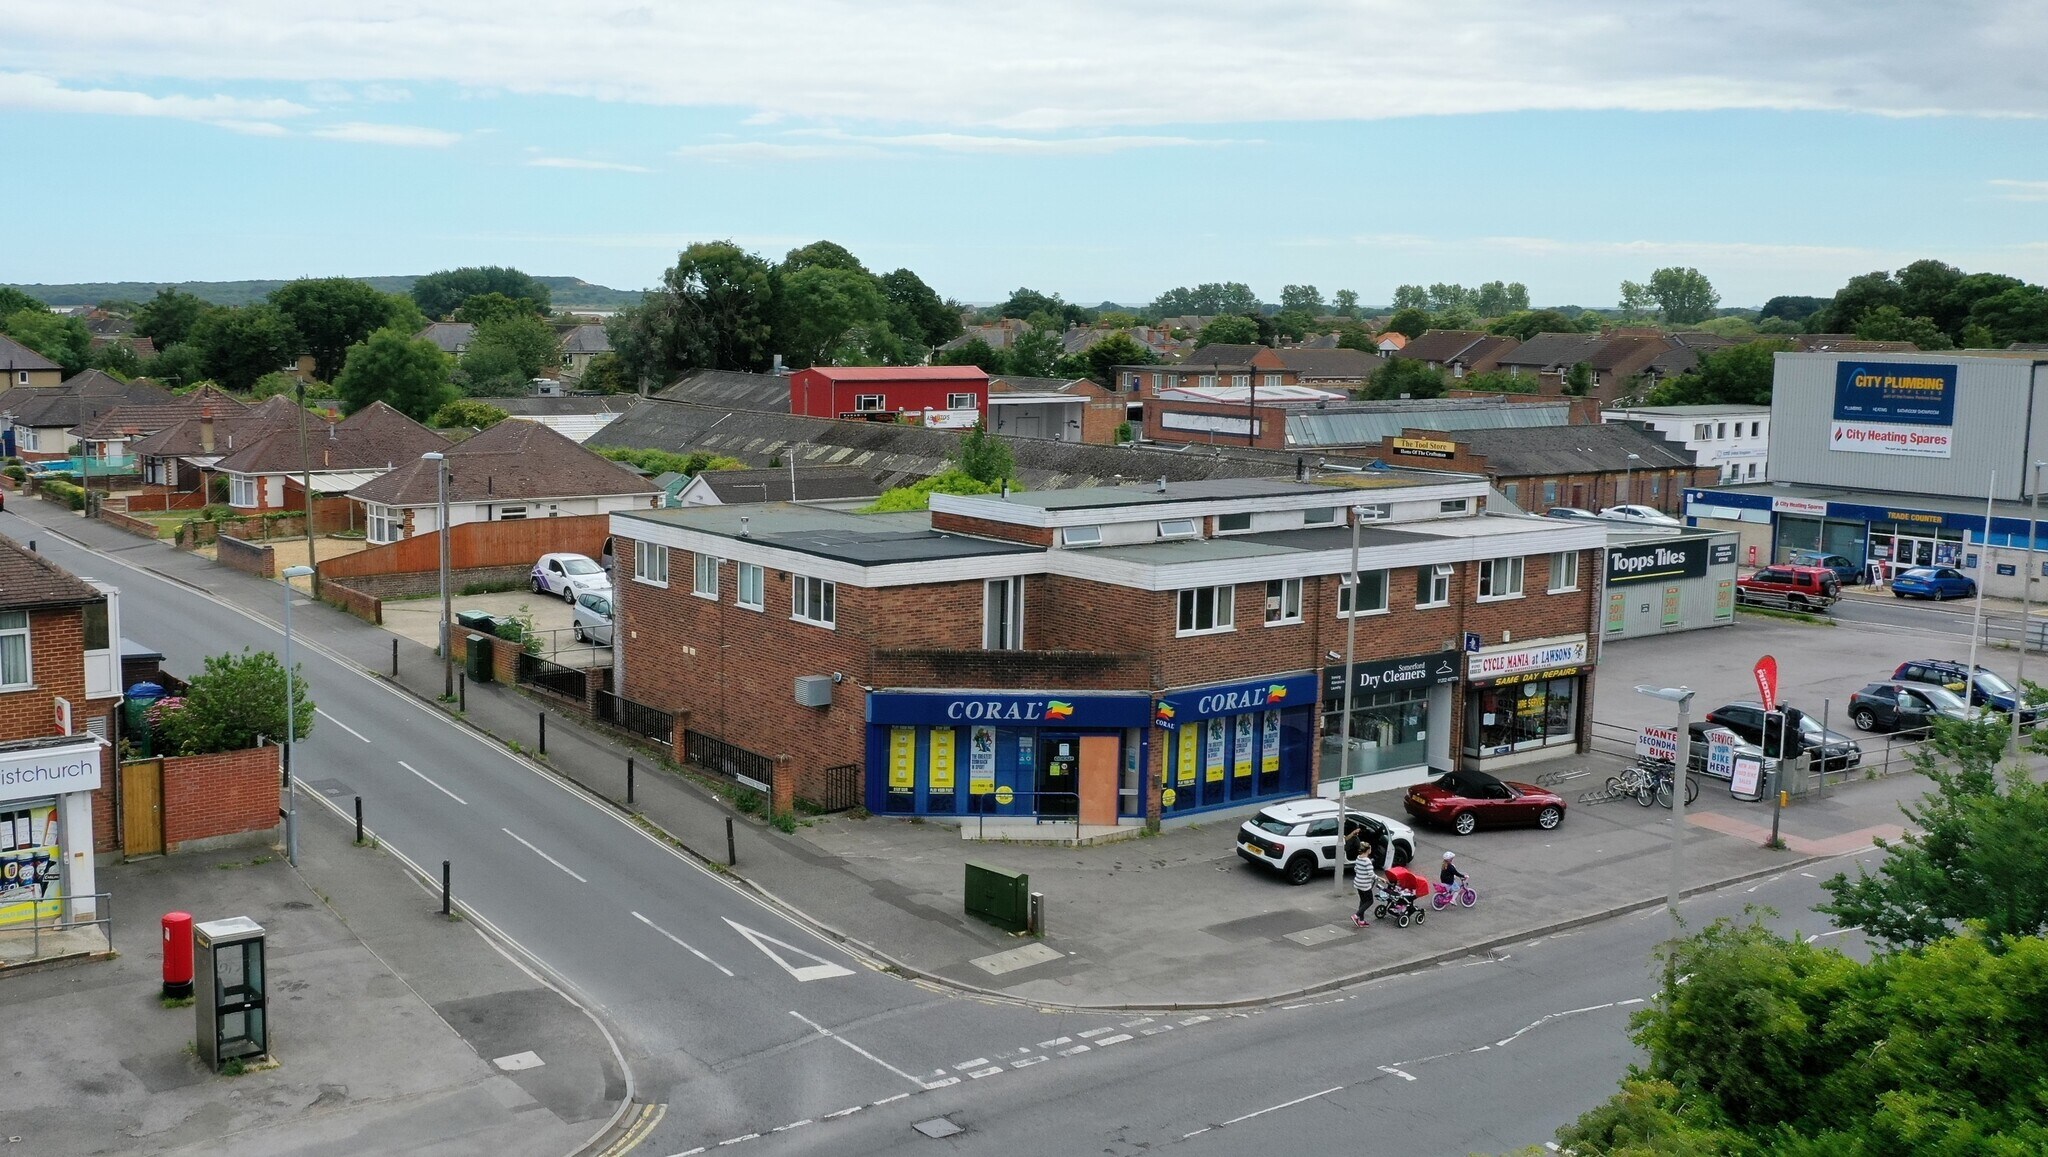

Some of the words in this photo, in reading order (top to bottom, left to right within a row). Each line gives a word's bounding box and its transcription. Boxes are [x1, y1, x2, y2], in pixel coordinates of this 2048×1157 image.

[1855, 375, 1882, 388] CITY
[1884, 376, 1944, 390] PLUMBING
[1846, 428, 1866, 440] City
[1868, 430, 1907, 444] Heating
[1910, 433, 1947, 445] Spares
[1415, 440, 1428, 448] Tool
[1430, 442, 1447, 450] Store
[1887, 511, 1910, 521] TRADE
[1911, 513, 1943, 524] COUNTER
[1612, 552, 1654, 572] Topps
[1655, 548, 1686, 566] Tiles
[1398, 662, 1426, 672] Somerford
[1483, 656, 1504, 672] CYCLE
[1506, 653, 1529, 668] MANIA
[1532, 656, 1539, 664] at
[1541, 648, 1572, 664] LAWSONS
[1360, 673, 1380, 688] Dry
[1382, 669, 1426, 683] Cleaners
[1494, 675, 1520, 686] SAME
[1522, 672, 1540, 682] DAY
[1542, 667, 1578, 679] REPAIRS
[1198, 688, 1264, 714] CORAL
[948, 701, 1040, 720] CORAL
[1156, 719, 1176, 730] CORAL
[1644, 727, 1677, 742] WANTE
[1711, 733, 1733, 746] SERVICE
[1639, 735, 1676, 750] SECONDHA
[1714, 745, 1729, 754] YOUR
[1649, 747, 1676, 761] BIKES
[1711, 753, 1729, 763] BIKE
[1709, 762, 1730, 774] HERE
